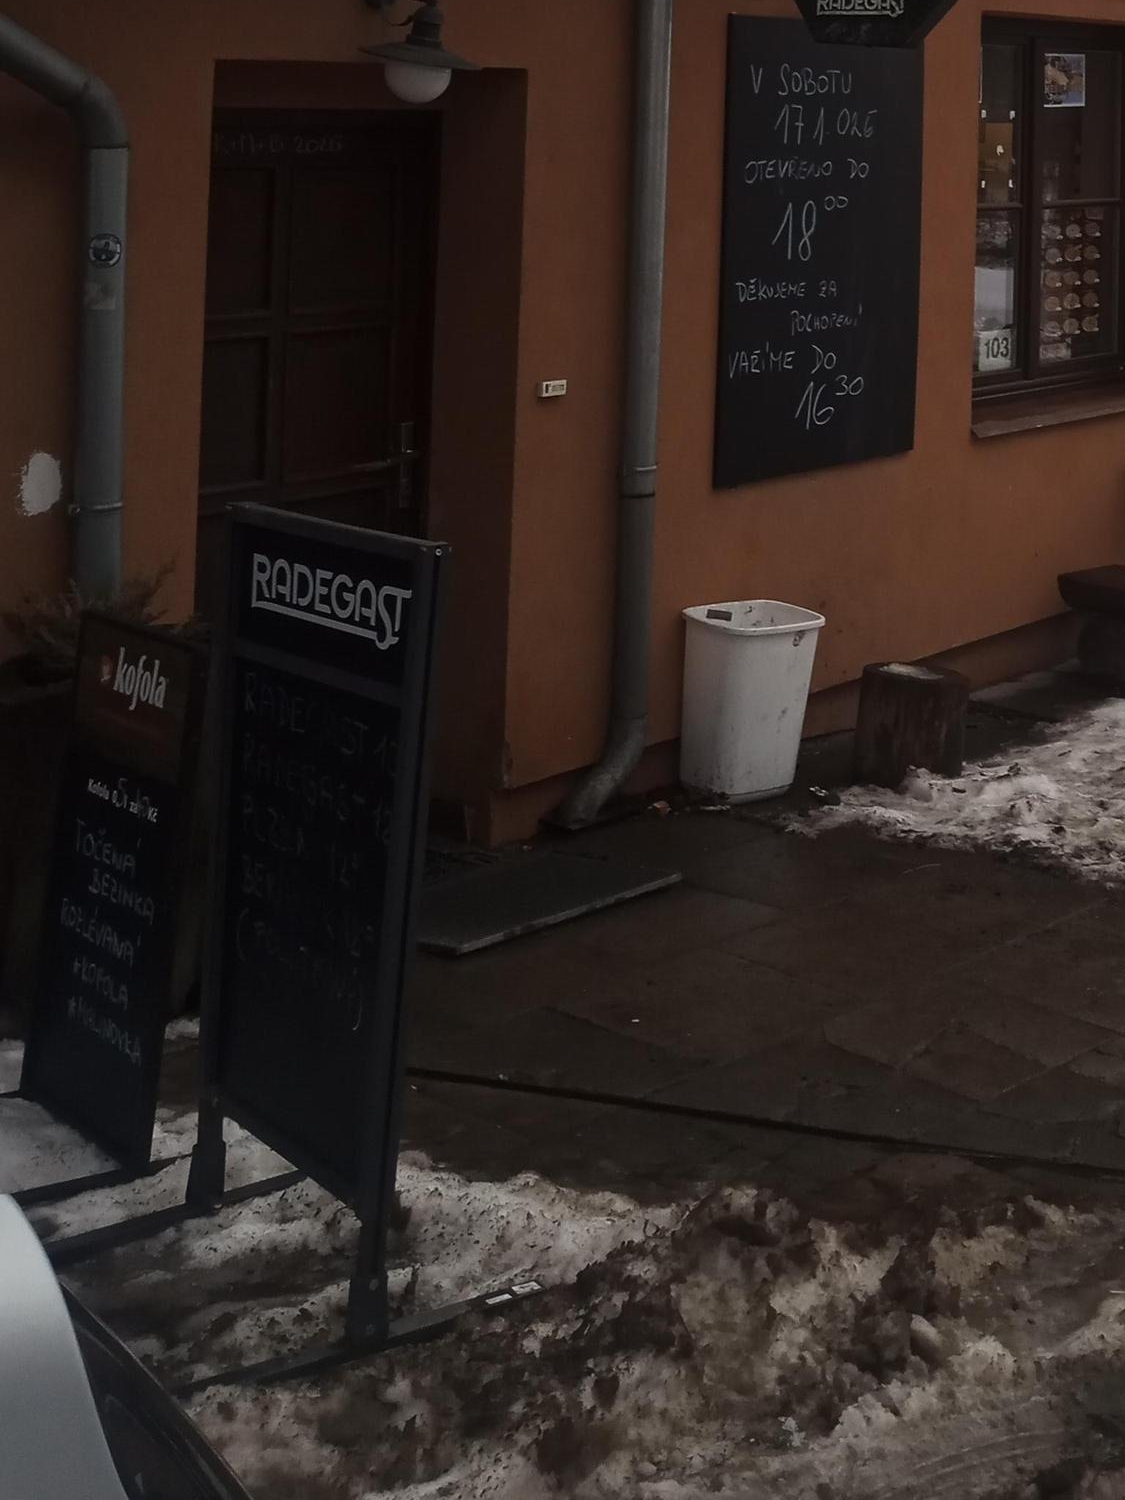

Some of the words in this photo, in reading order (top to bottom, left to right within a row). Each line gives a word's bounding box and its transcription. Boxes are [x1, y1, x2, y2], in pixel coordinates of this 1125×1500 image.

[750, 63, 764, 95] V
[777, 62, 852, 96] SOBOTU
[744, 156, 833, 184] OTEVŘENO
[847, 157, 870, 180] DO
[818, 279, 838, 298] ZA
[811, 344, 837, 375] DO
[984, 337, 1010, 359] 103
[250, 552, 413, 651] RADEGAST
[112, 646, 166, 712] kofola
